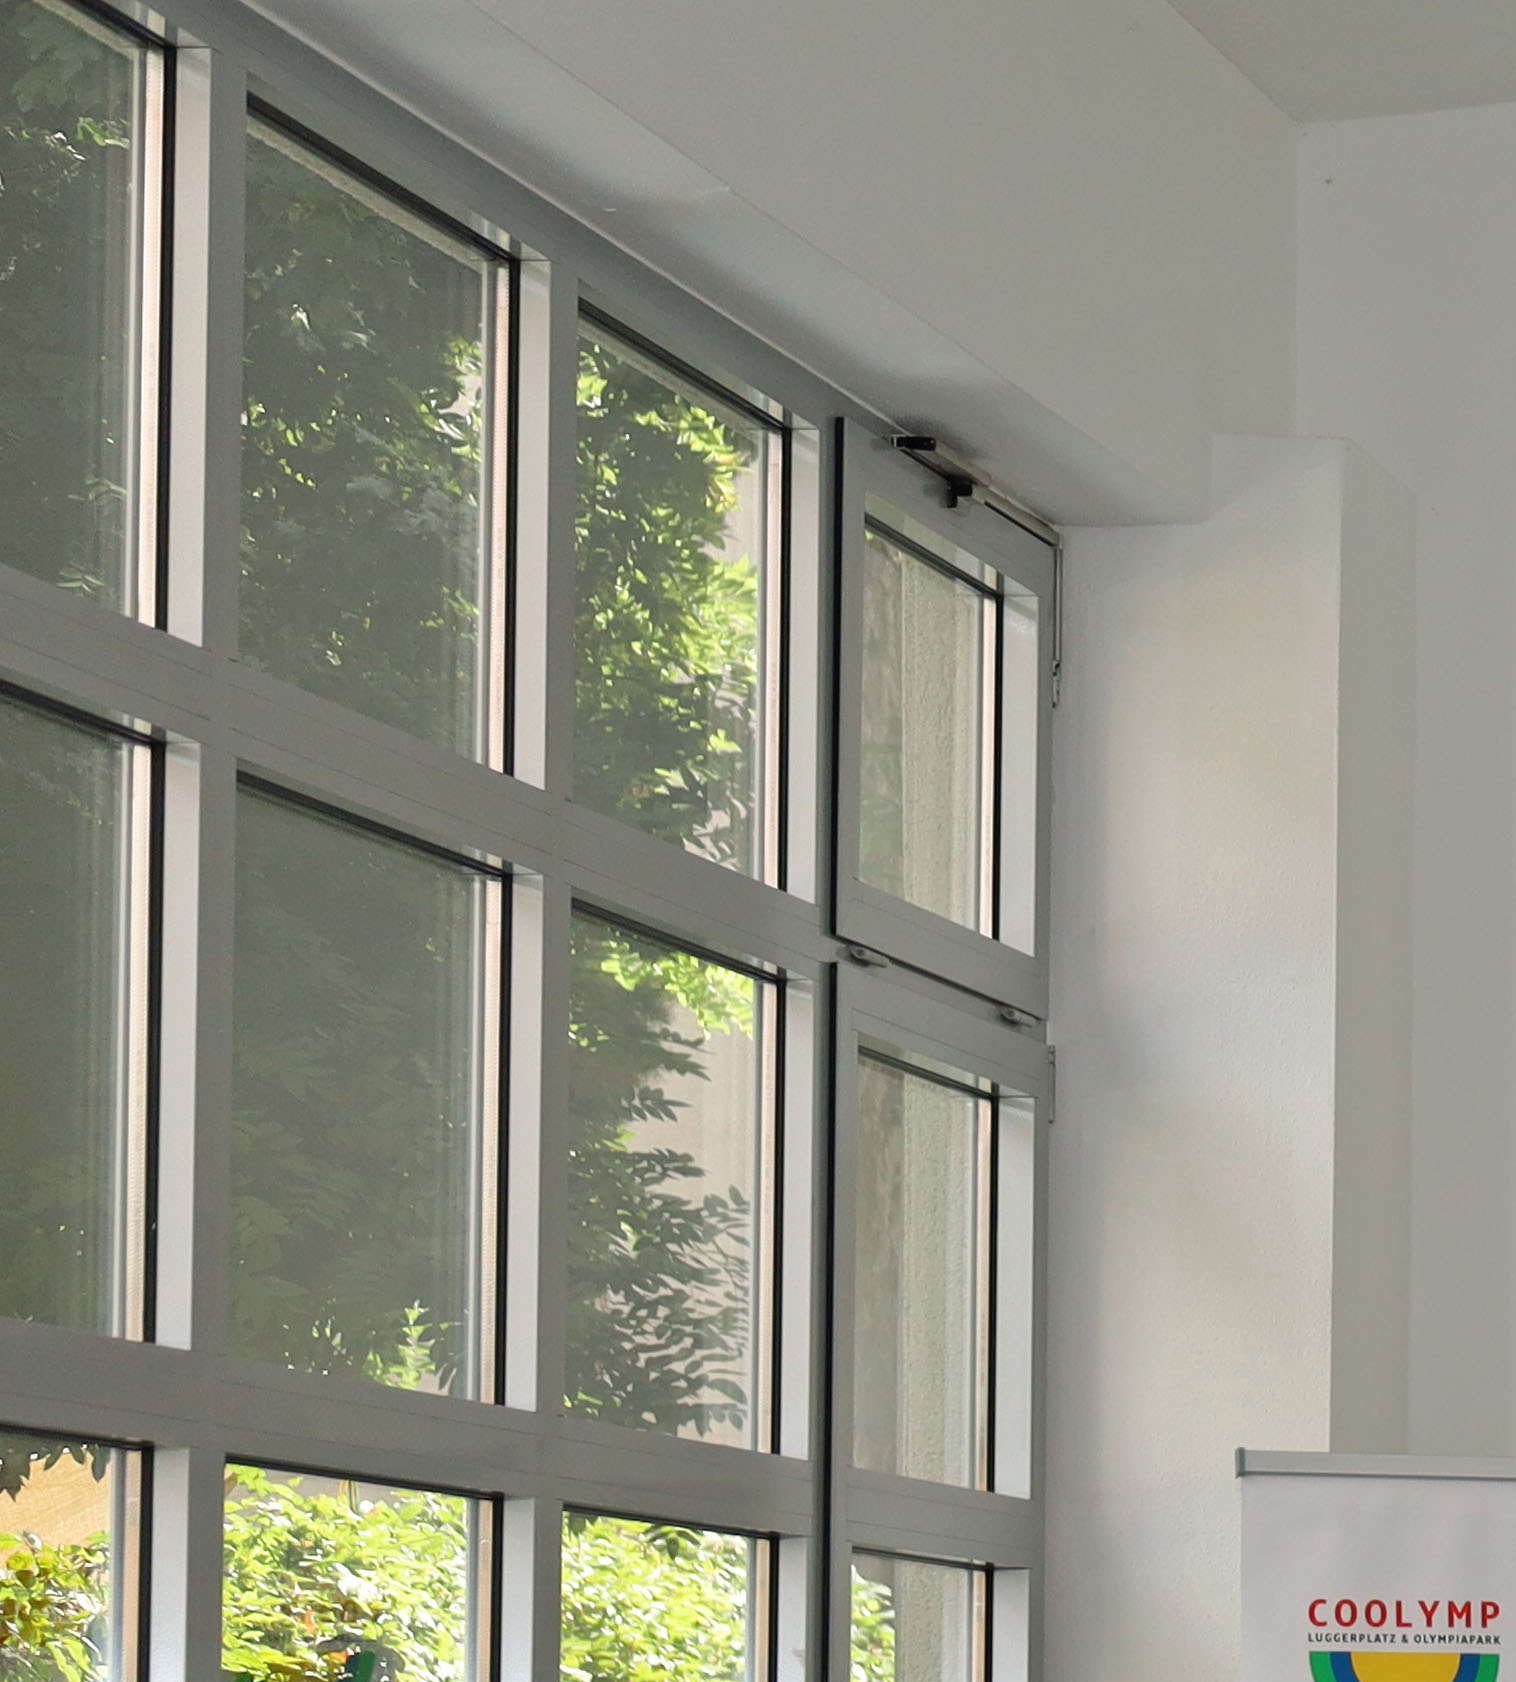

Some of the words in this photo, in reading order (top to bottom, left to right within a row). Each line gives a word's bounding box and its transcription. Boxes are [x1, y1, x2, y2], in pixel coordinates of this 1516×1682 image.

[1307, 1598, 1500, 1629] COOLYMP
[1307, 1632, 1397, 1643] LUGGERPLATZ
[1401, 1634, 1409, 1643] &
[1413, 1634, 1501, 1645] OLYMPIAPARK
